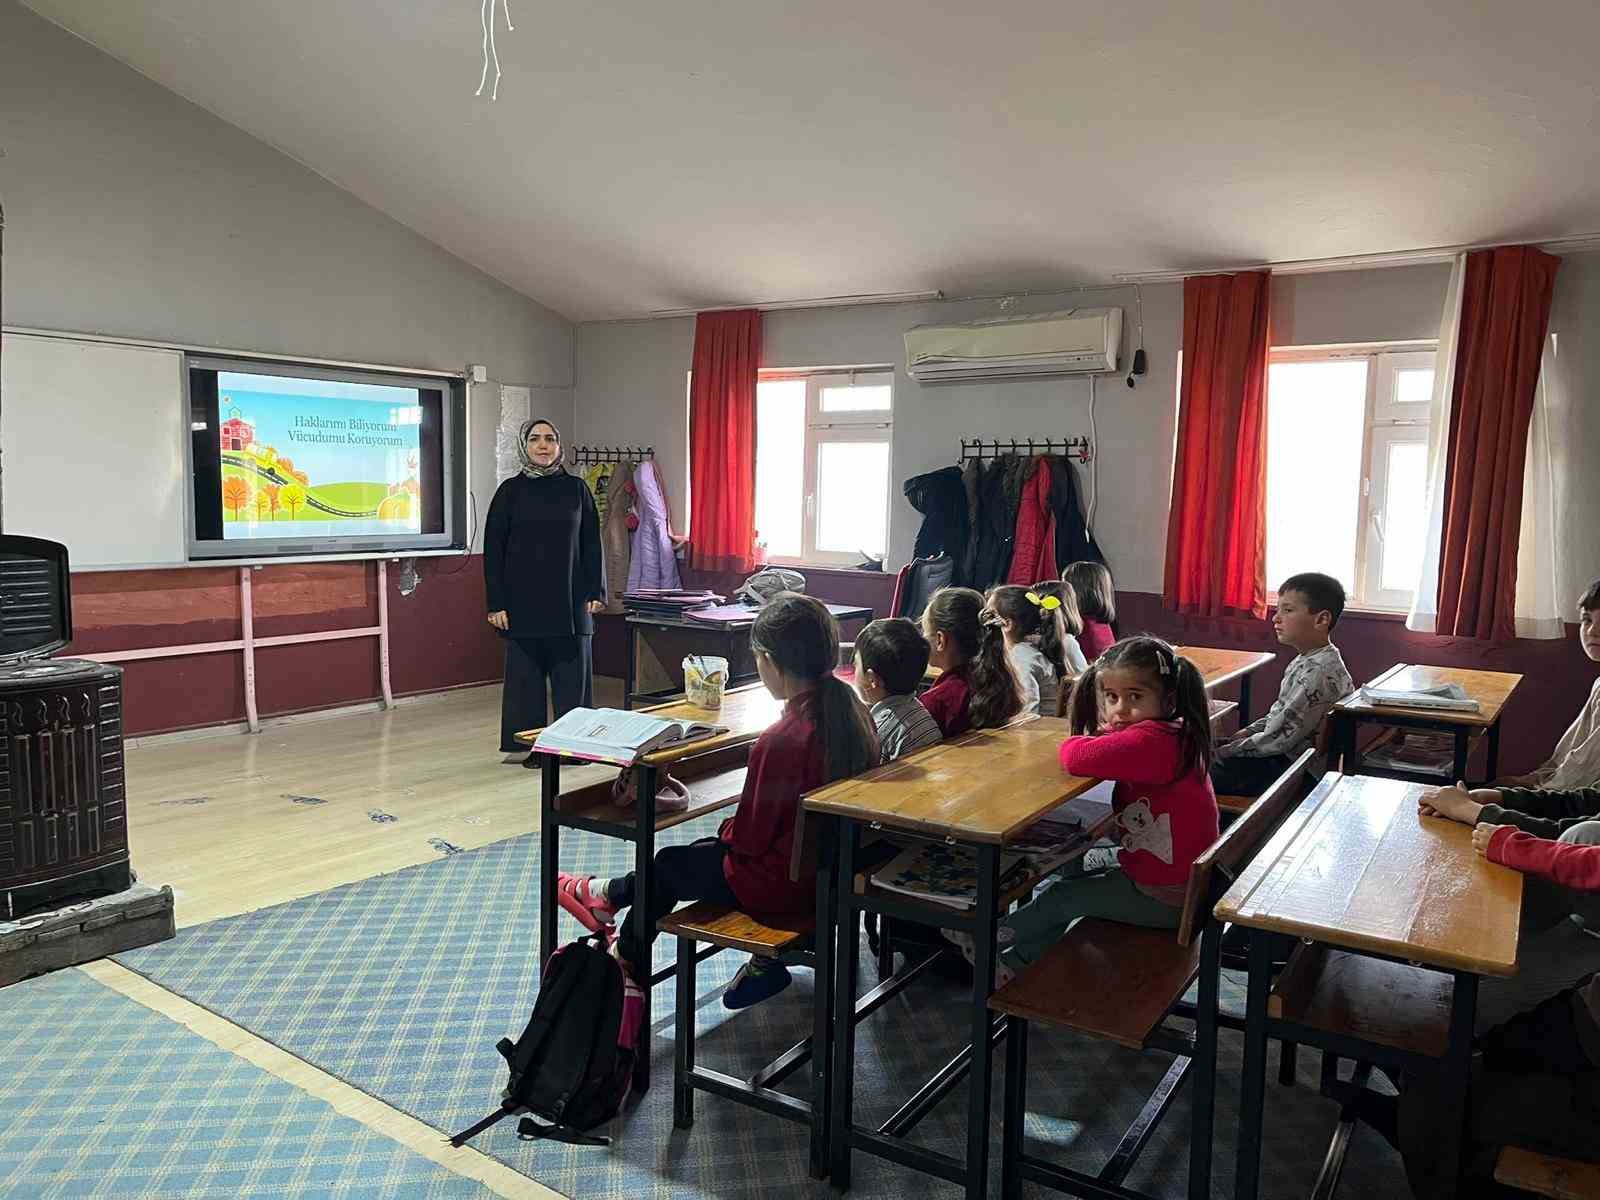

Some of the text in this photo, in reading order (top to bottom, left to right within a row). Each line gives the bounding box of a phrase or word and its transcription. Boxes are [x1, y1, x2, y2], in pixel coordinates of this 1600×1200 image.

[349, 418, 398, 433] Biliyorum
[287, 429, 403, 449] Vücudumu Koruyorum
